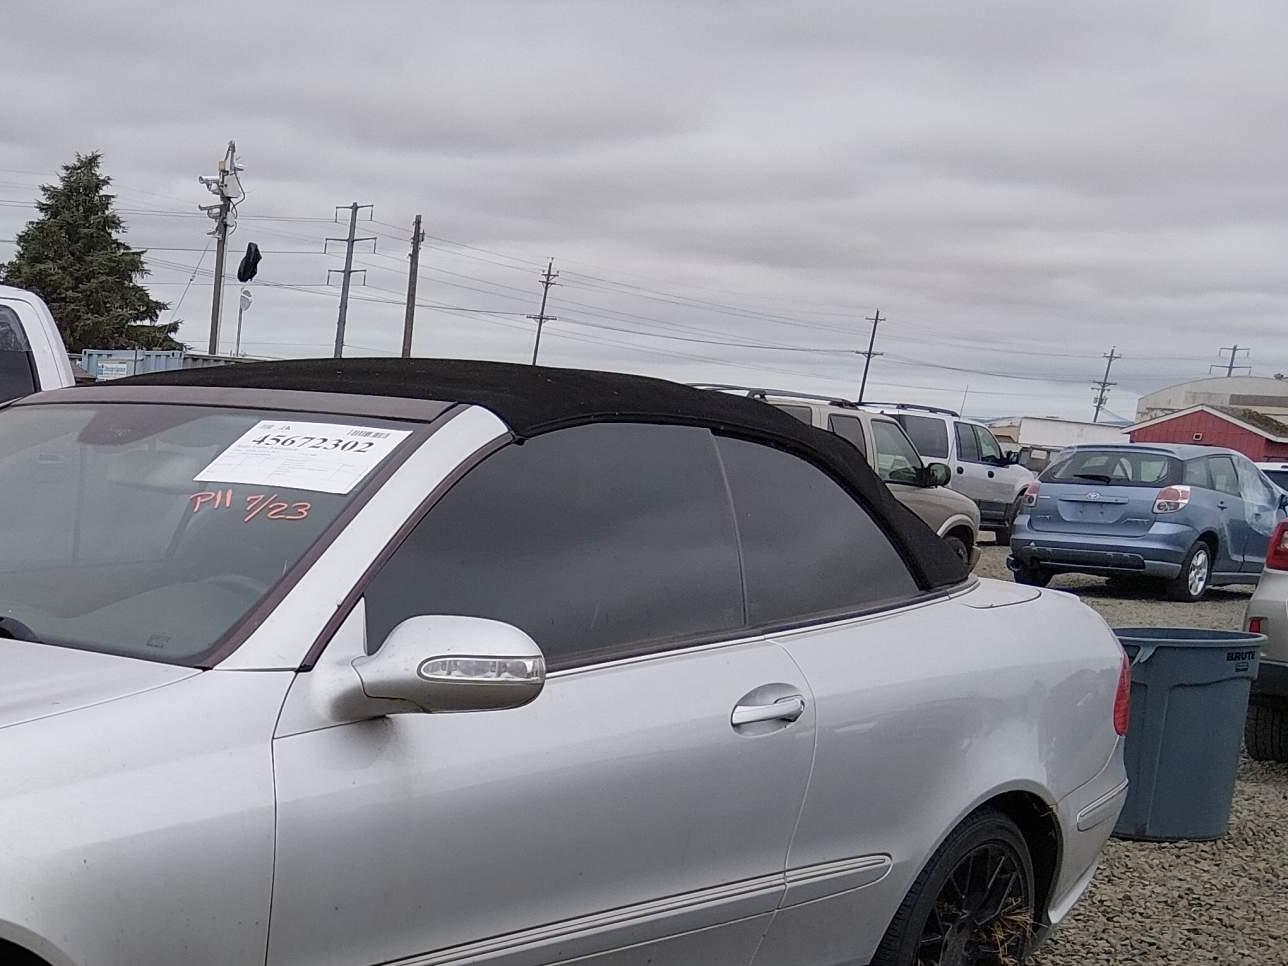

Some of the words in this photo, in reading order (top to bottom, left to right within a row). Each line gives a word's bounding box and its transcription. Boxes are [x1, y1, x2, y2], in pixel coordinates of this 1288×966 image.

[251, 434, 375, 454] 45672302
[243, 493, 312, 523] 7/23
[1226, 650, 1256, 661] BRUTE
